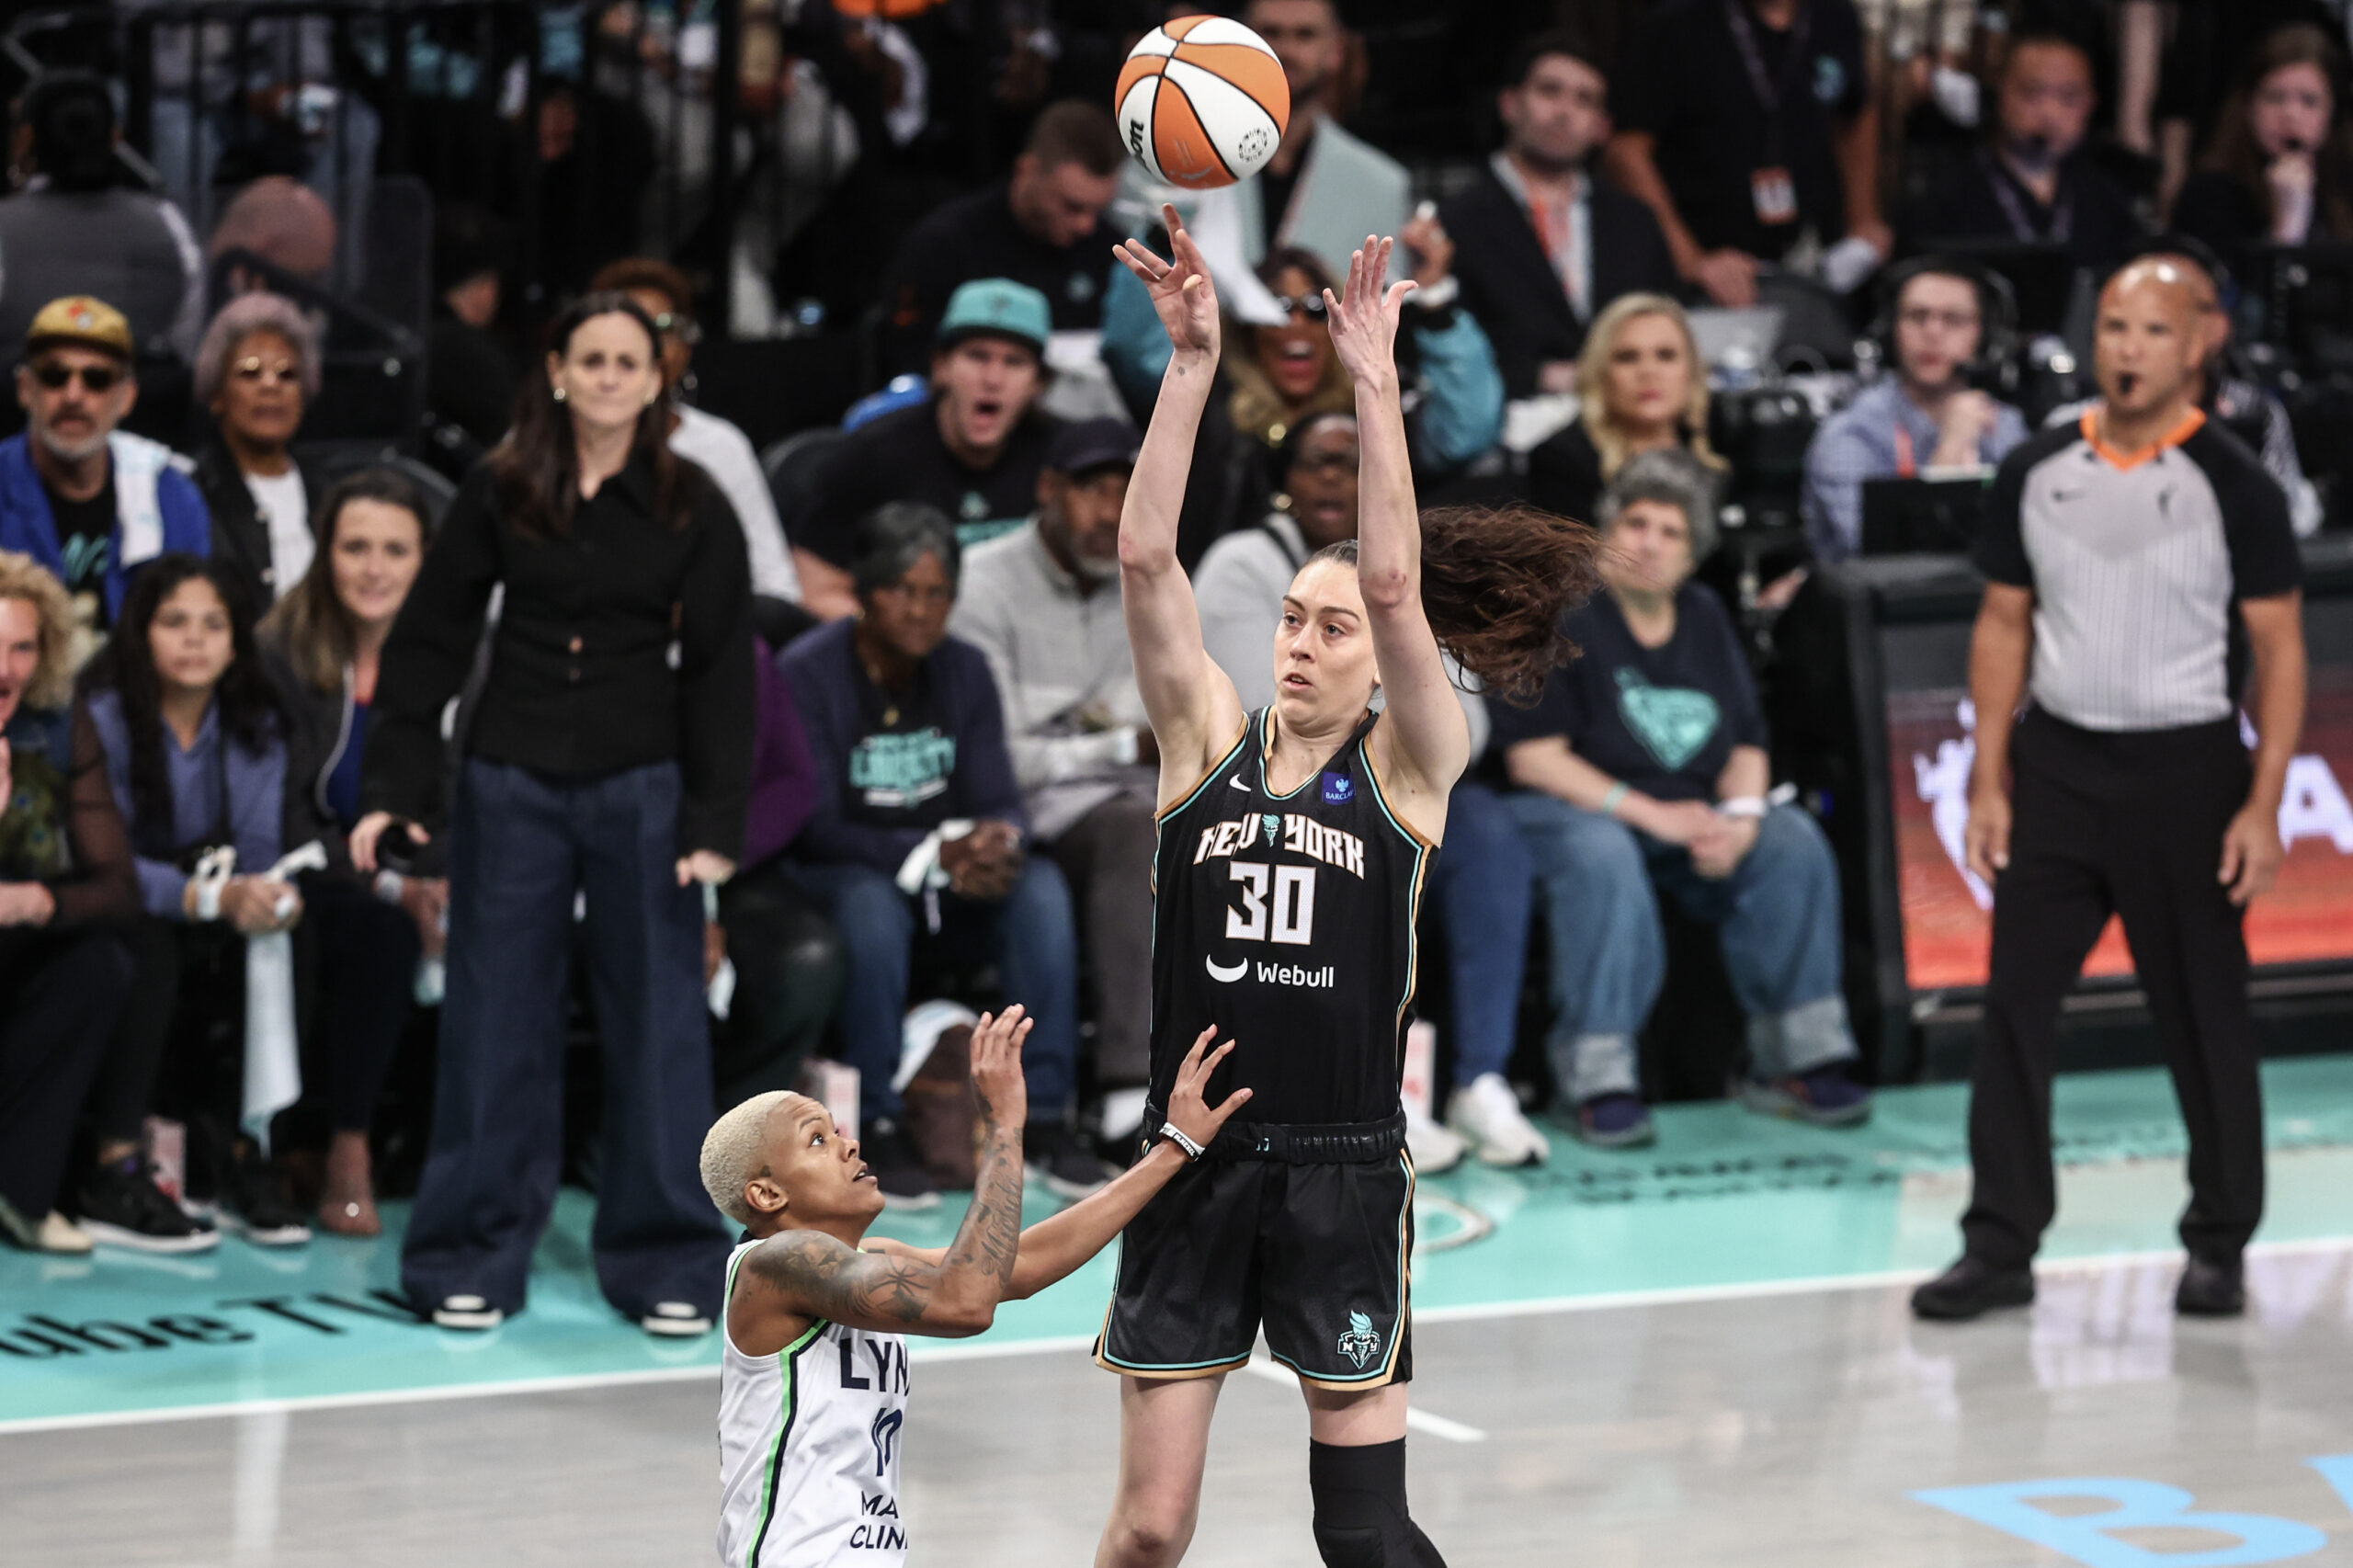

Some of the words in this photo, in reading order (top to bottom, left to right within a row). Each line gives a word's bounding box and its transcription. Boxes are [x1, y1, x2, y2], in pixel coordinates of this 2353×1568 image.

[1193, 812, 1261, 865] NEW
[1284, 813, 1365, 880] YORK
[1225, 861, 1317, 945] 30
[1256, 961, 1335, 988] Webull
[839, 1337, 910, 1396] LYN
[861, 1490, 899, 1519] MA
[1901, 1452, 2353, 1568] B
